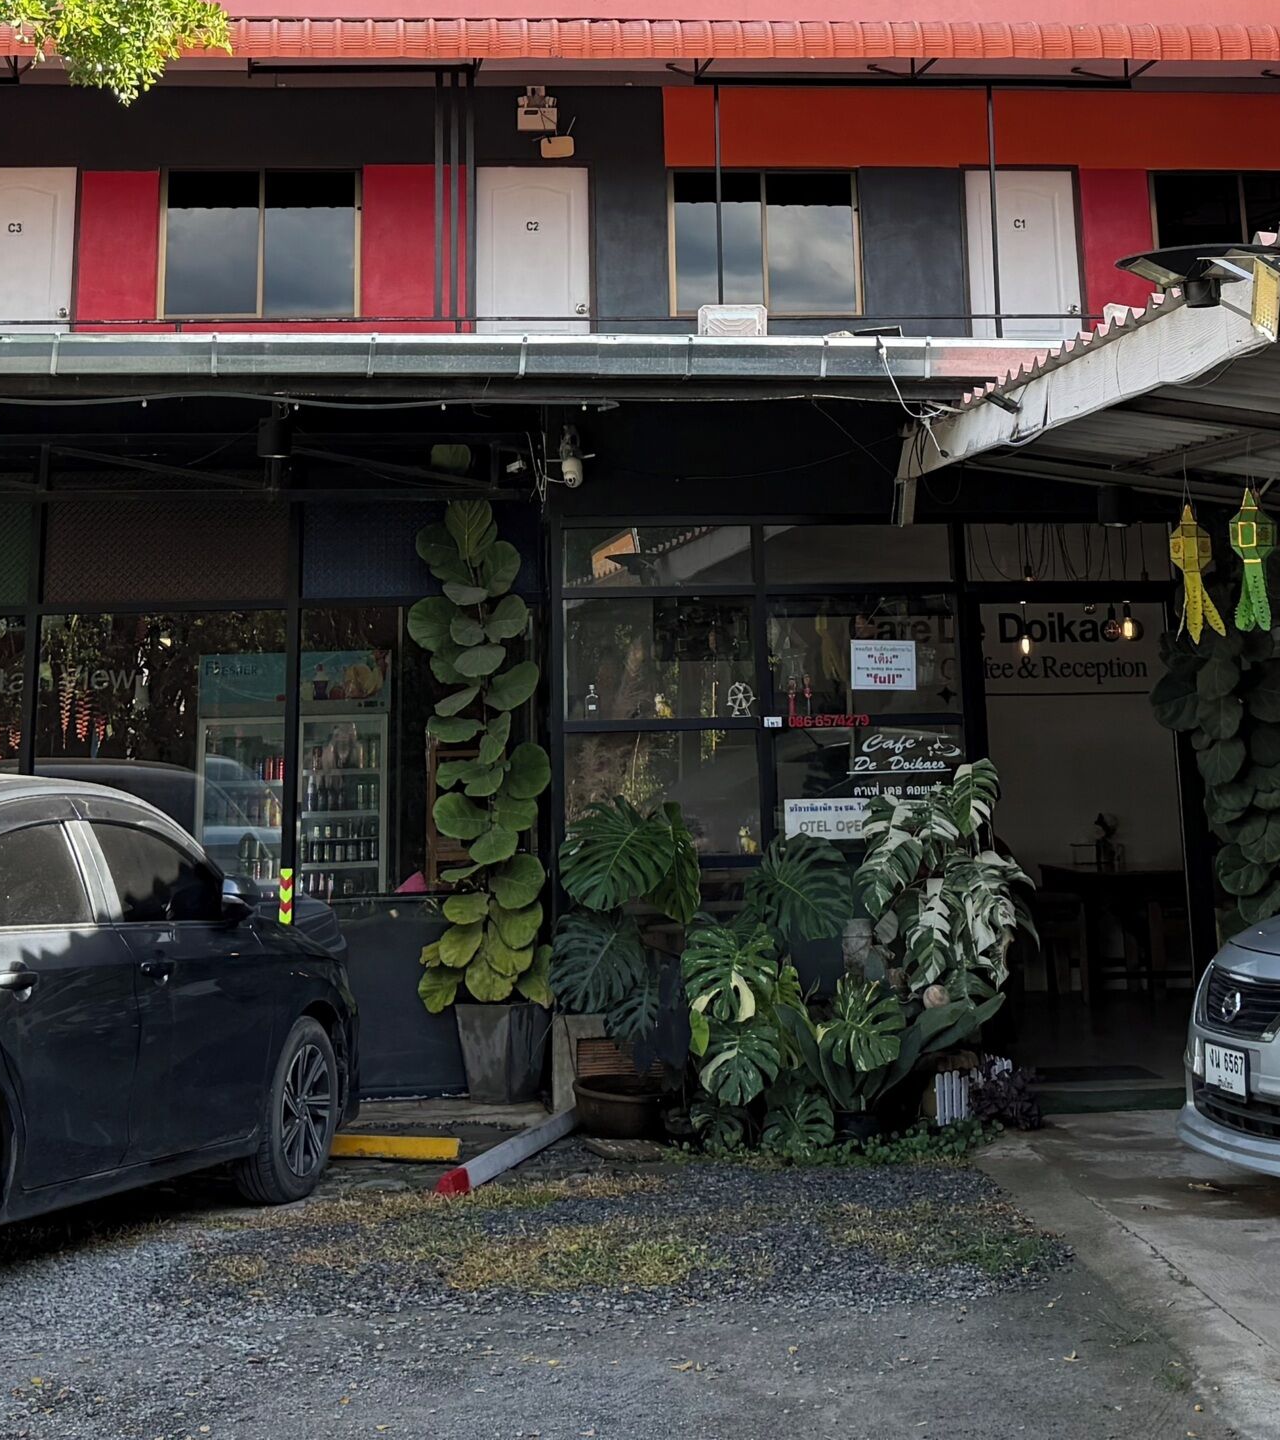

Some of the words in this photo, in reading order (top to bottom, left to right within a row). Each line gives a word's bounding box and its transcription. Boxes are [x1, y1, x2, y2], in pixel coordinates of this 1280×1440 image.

[8, 223, 22, 233] C3
[526, 221, 540, 231] C2
[1013, 219, 1026, 229] C1
[1018, 658, 1038, 679] &
[1042, 656, 1148, 685] Reception
[788, 714, 871, 729] 086-6574279
[854, 756, 878, 772] De
[885, 755, 947, 771] Doikaeo
[1224, 1052, 1244, 1076] 6567
